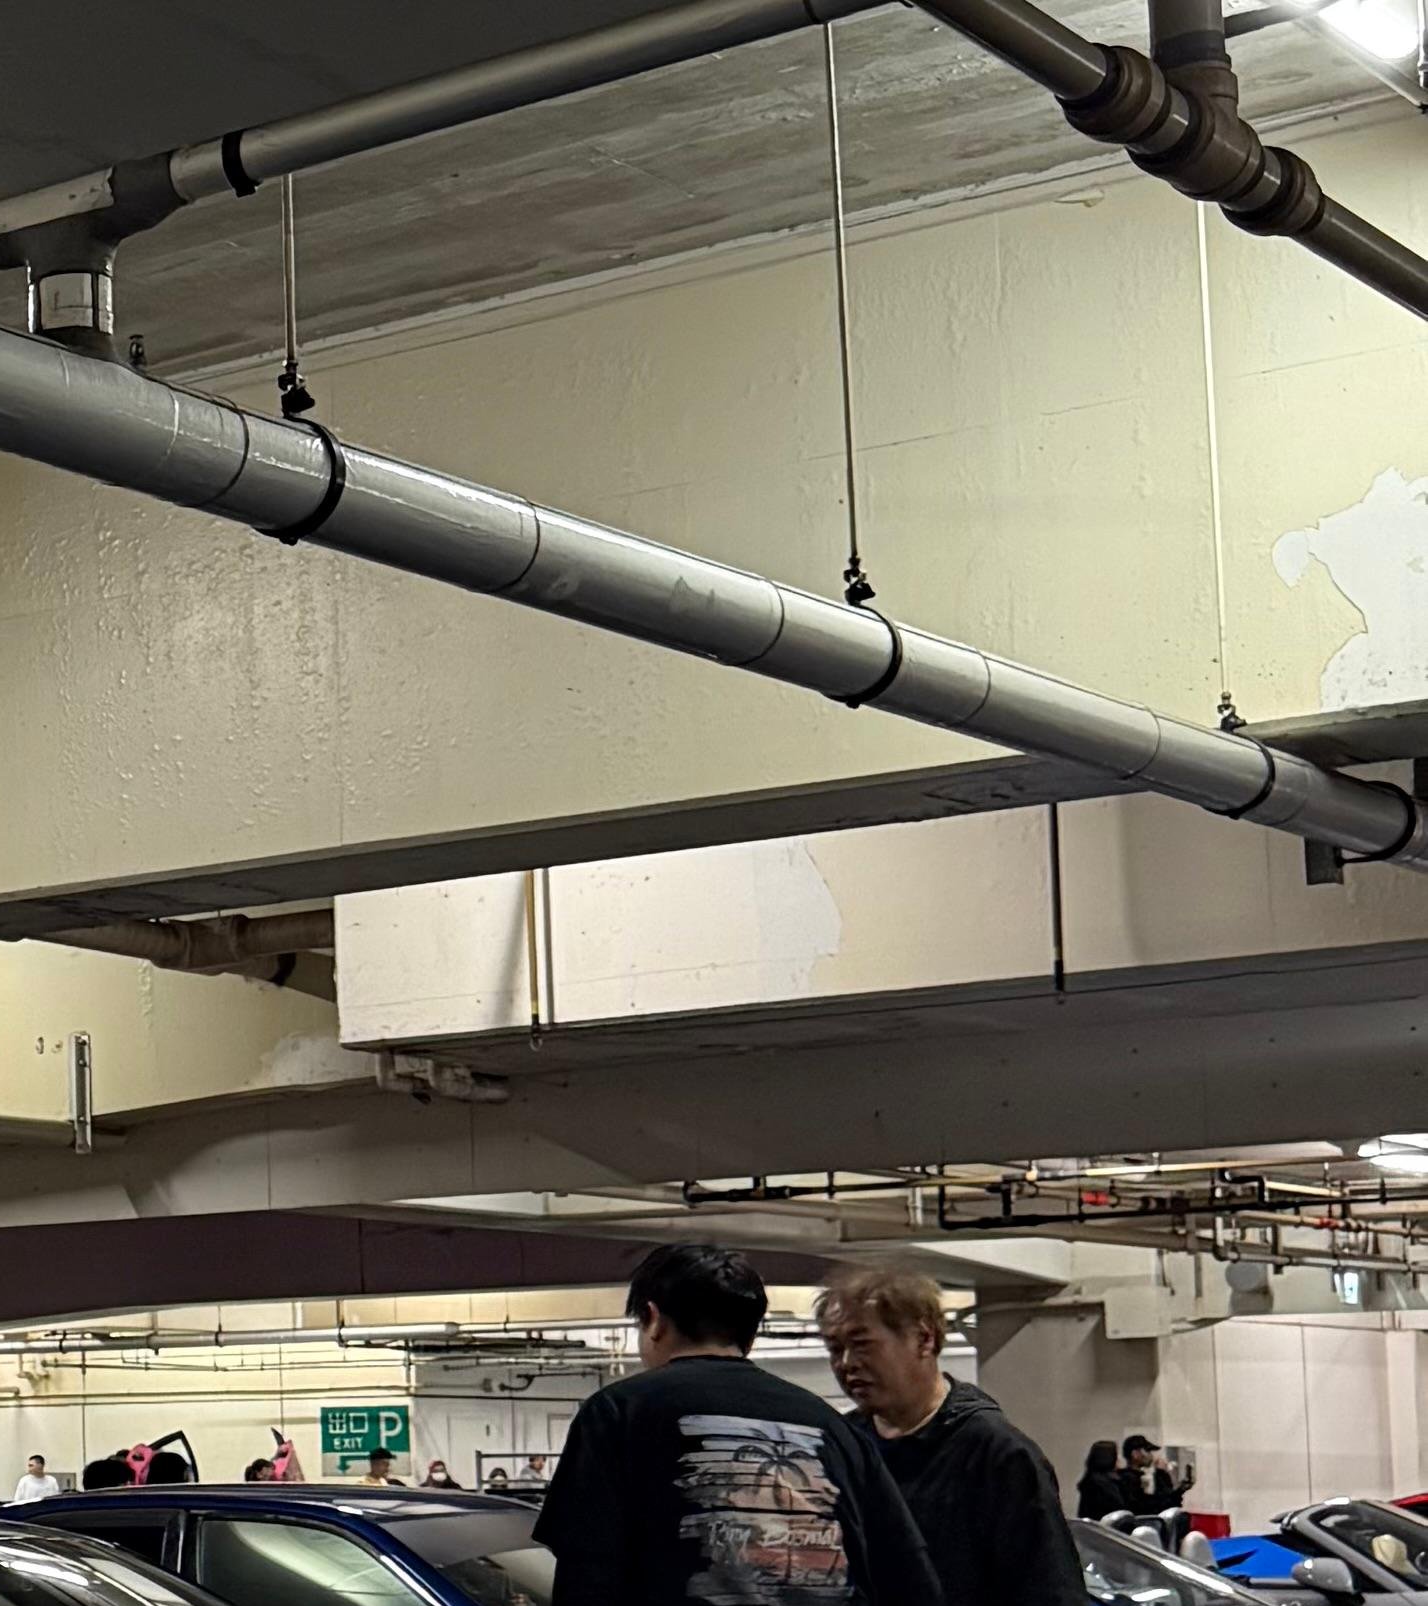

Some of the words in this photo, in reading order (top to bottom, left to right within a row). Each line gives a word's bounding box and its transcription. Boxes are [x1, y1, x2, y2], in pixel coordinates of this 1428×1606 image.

[328, 1412, 369, 1434] 出口
[379, 1411, 403, 1449] P
[333, 1436, 364, 1450] EXIT
